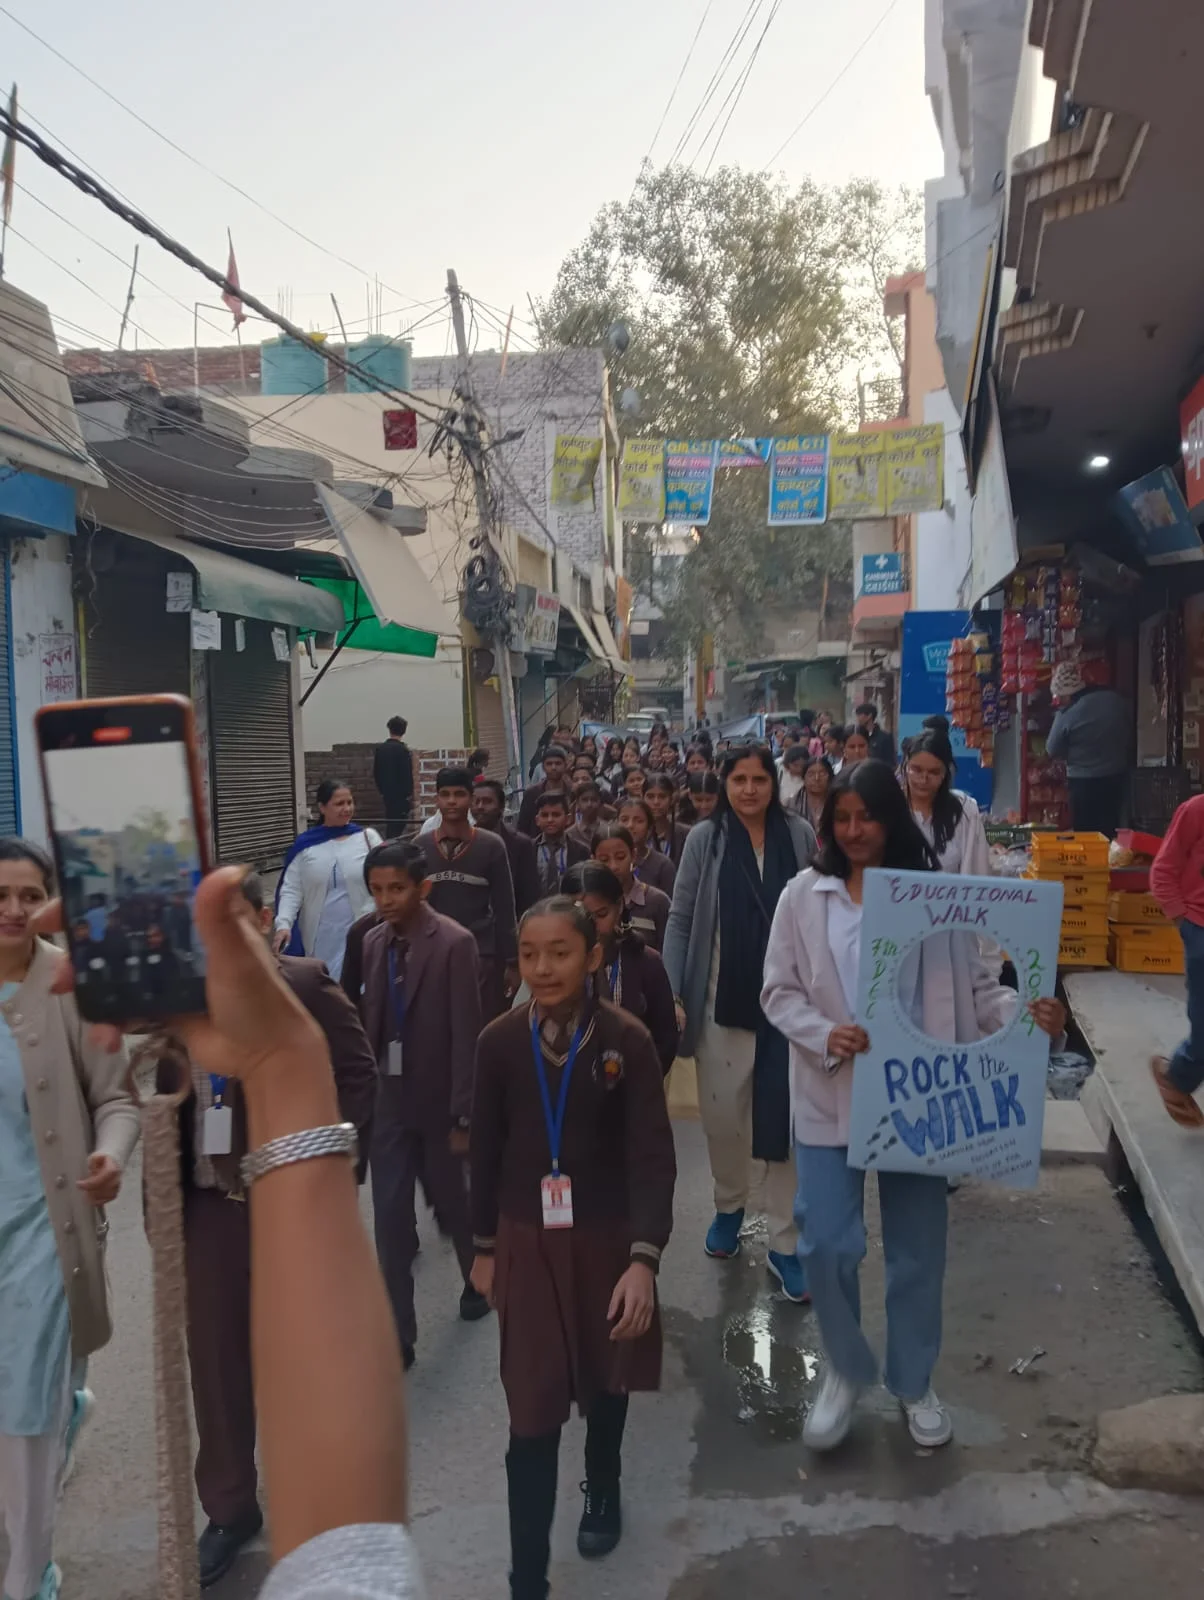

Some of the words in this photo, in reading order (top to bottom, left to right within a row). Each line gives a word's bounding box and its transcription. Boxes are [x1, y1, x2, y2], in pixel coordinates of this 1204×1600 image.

[885, 874, 1039, 905] EDUCATIONAL
[924, 903, 990, 928] WALK
[884, 1052, 971, 1104] ROCK
[978, 1052, 1009, 1081] the
[890, 1072, 1026, 1157] WALK
